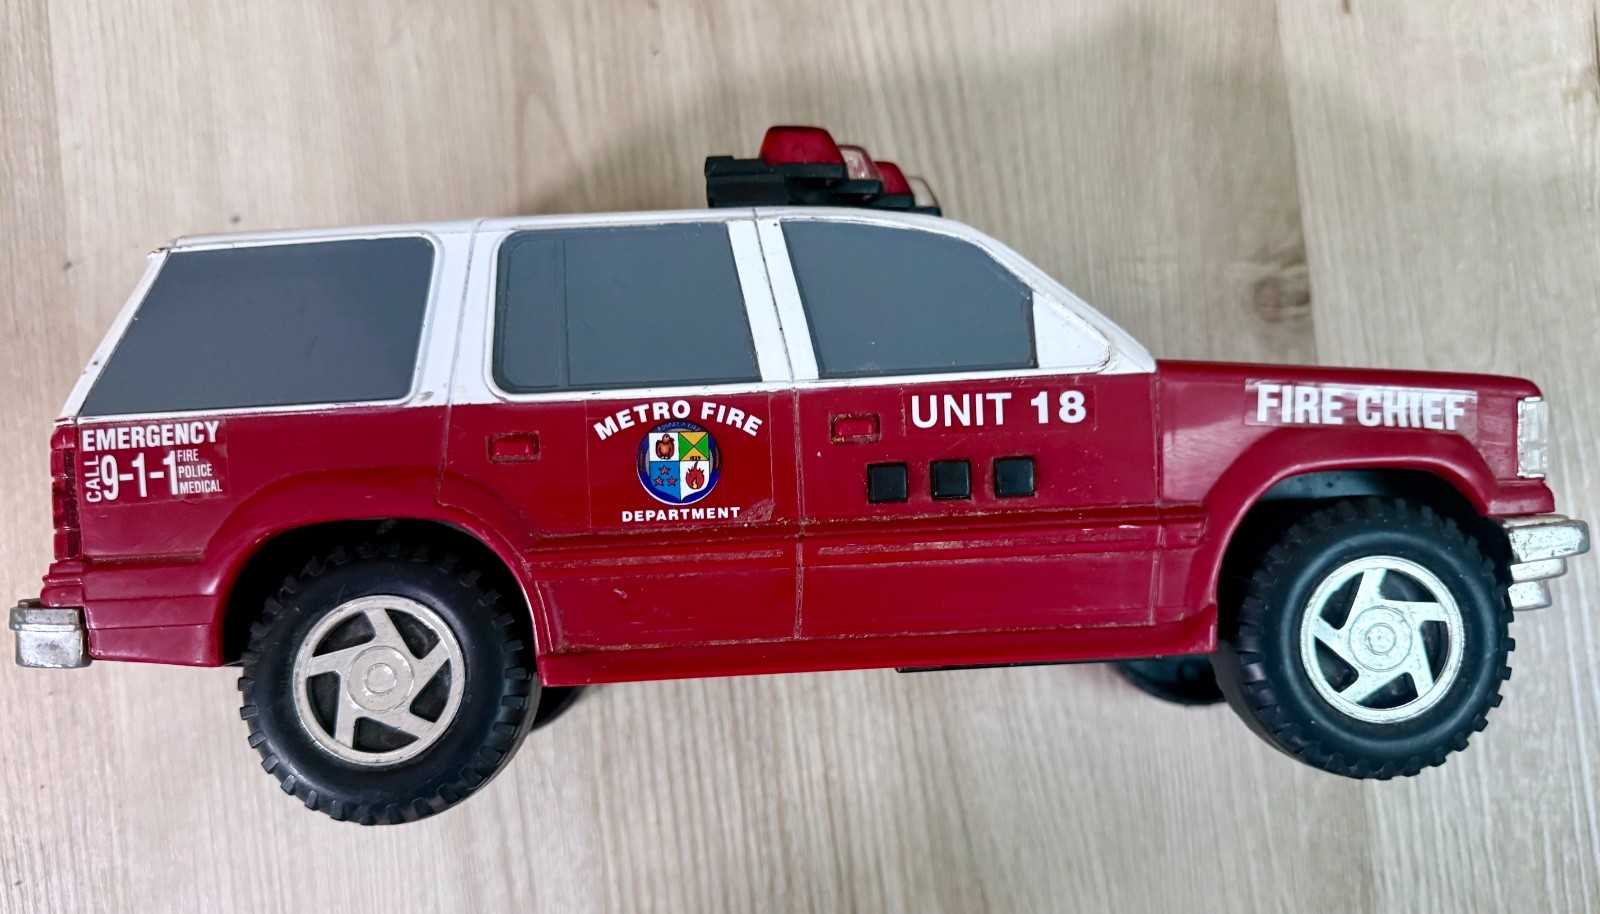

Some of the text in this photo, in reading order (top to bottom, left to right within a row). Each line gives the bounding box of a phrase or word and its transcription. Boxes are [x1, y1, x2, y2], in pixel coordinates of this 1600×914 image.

[593, 400, 763, 440] METRO FIRE
[911, 390, 1087, 428] UNIT 18
[1257, 384, 1465, 430] FIRE CHIEF
[82, 420, 219, 451] EMERGENCY
[177, 448, 199, 462] FIRE
[178, 464, 212, 478] POLICE
[84, 455, 102, 502] CALL
[101, 450, 178, 500] 9-1-1
[179, 480, 223, 494] MEDICAL
[621, 507, 741, 523] DEPARTMENT
